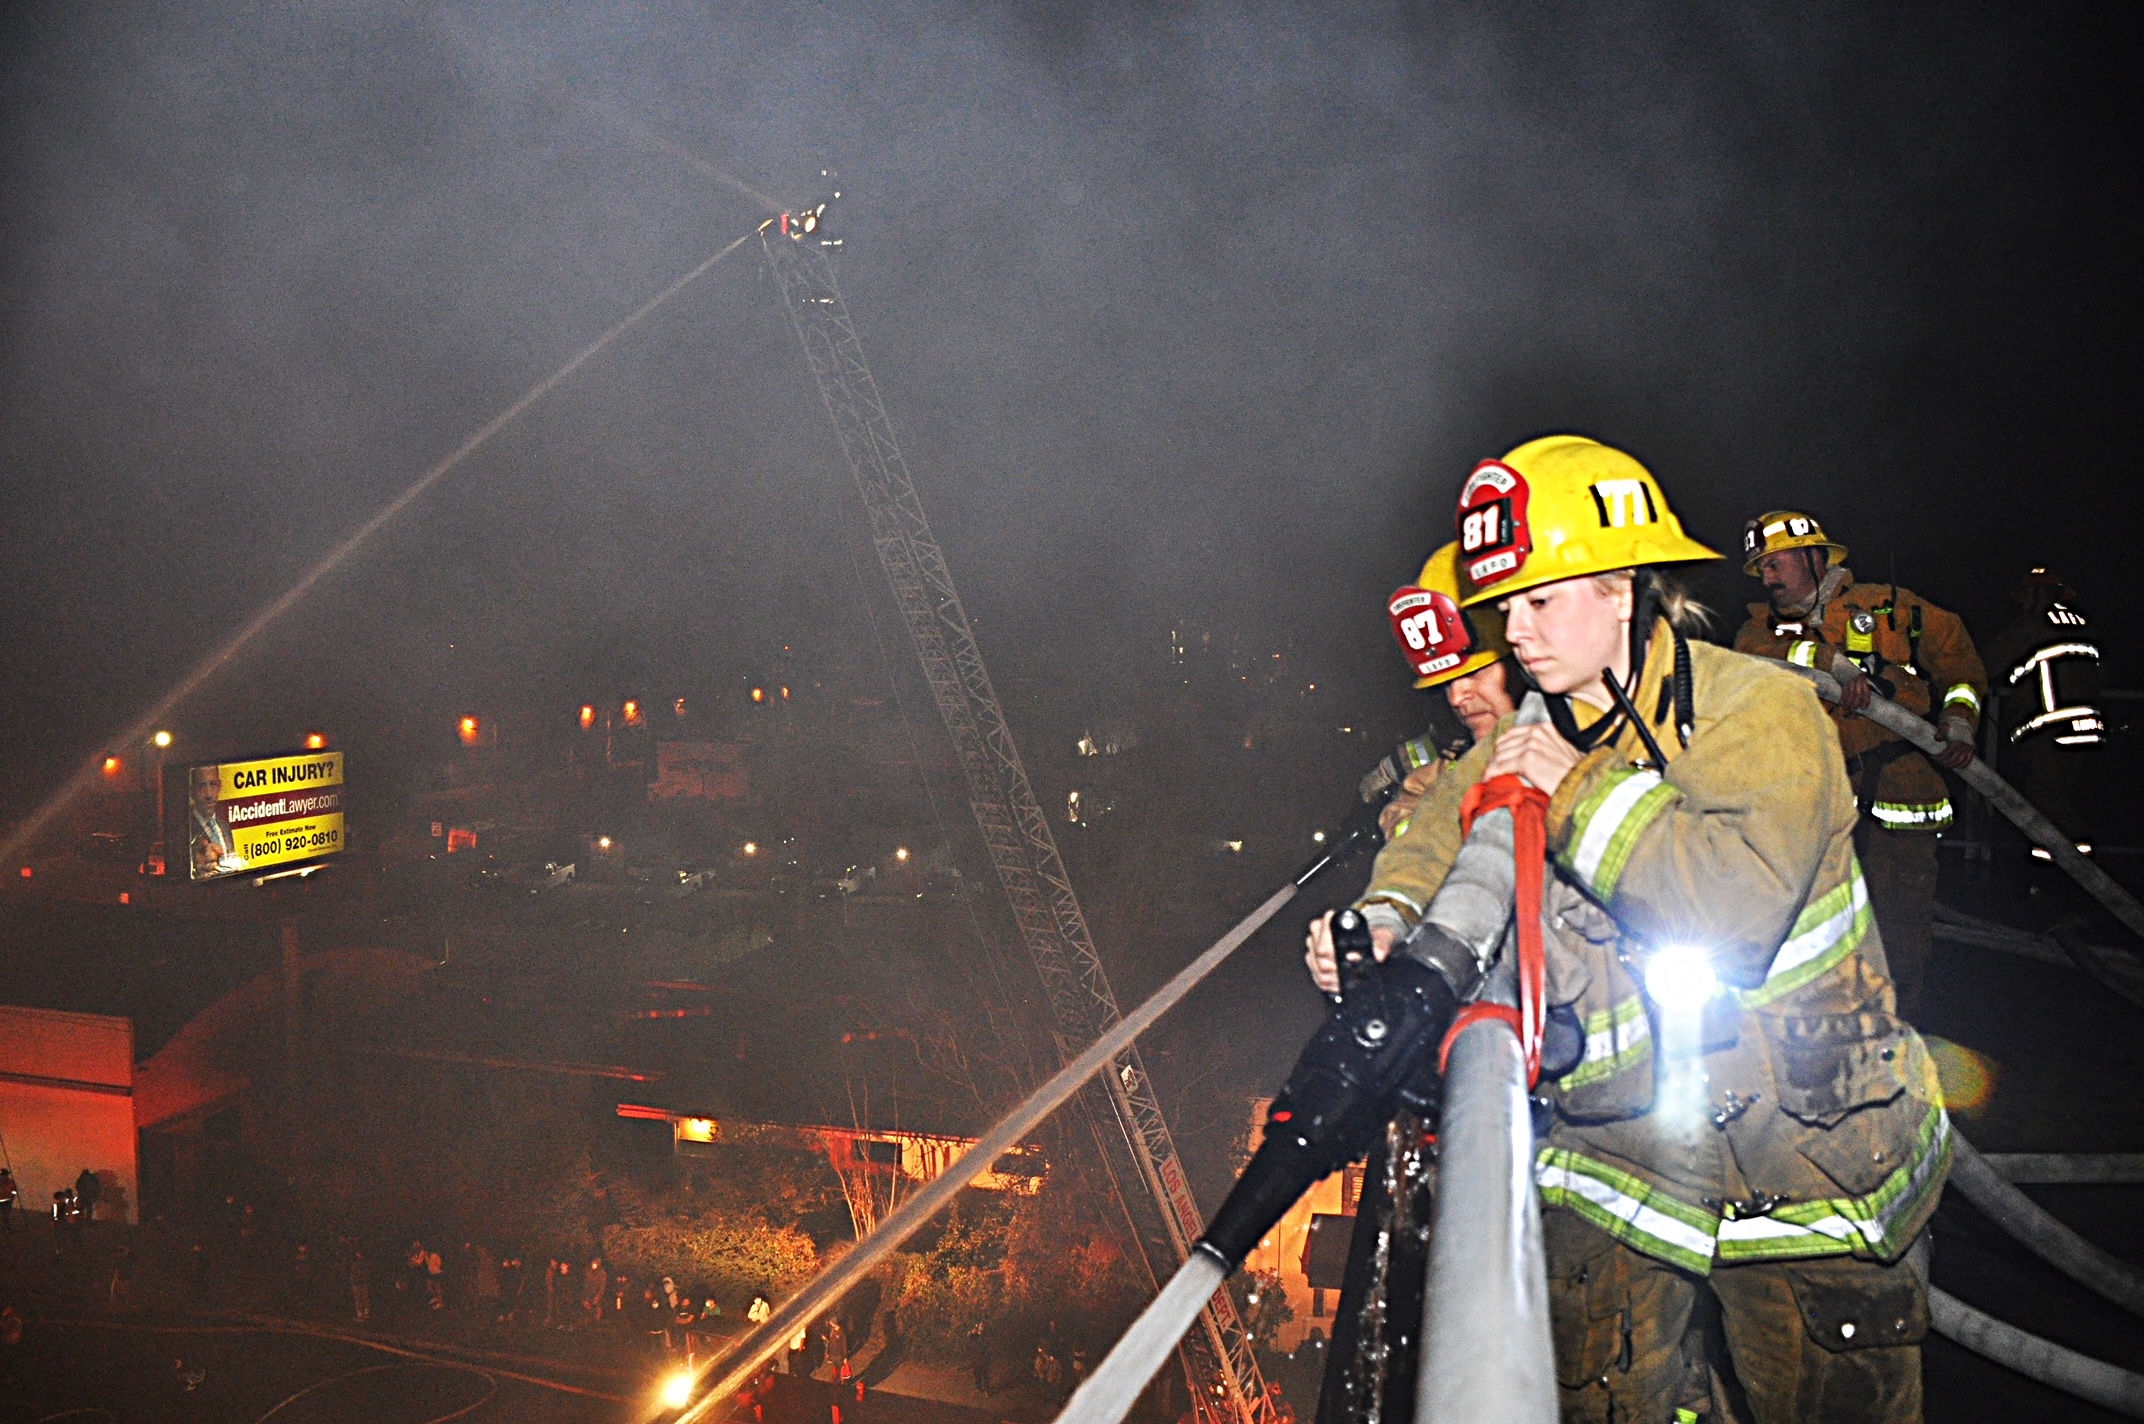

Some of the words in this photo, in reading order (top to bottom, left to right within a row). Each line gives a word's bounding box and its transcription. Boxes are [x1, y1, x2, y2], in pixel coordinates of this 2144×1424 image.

[1463, 504, 1499, 551] 81
[1744, 530, 1755, 552] 1
[1400, 609, 1443, 650] 87
[234, 769, 267, 789] CAR
[272, 761, 334, 784] INJURY?
[228, 794, 338, 823] iAccidentLawyer.com
[250, 838, 281, 859] (800)
[285, 829, 338, 851] 920-0810
[280, 826, 303, 835] Estimate
[1162, 1160, 1181, 1194] LOS
[1174, 1194, 1199, 1242] ANGEL
